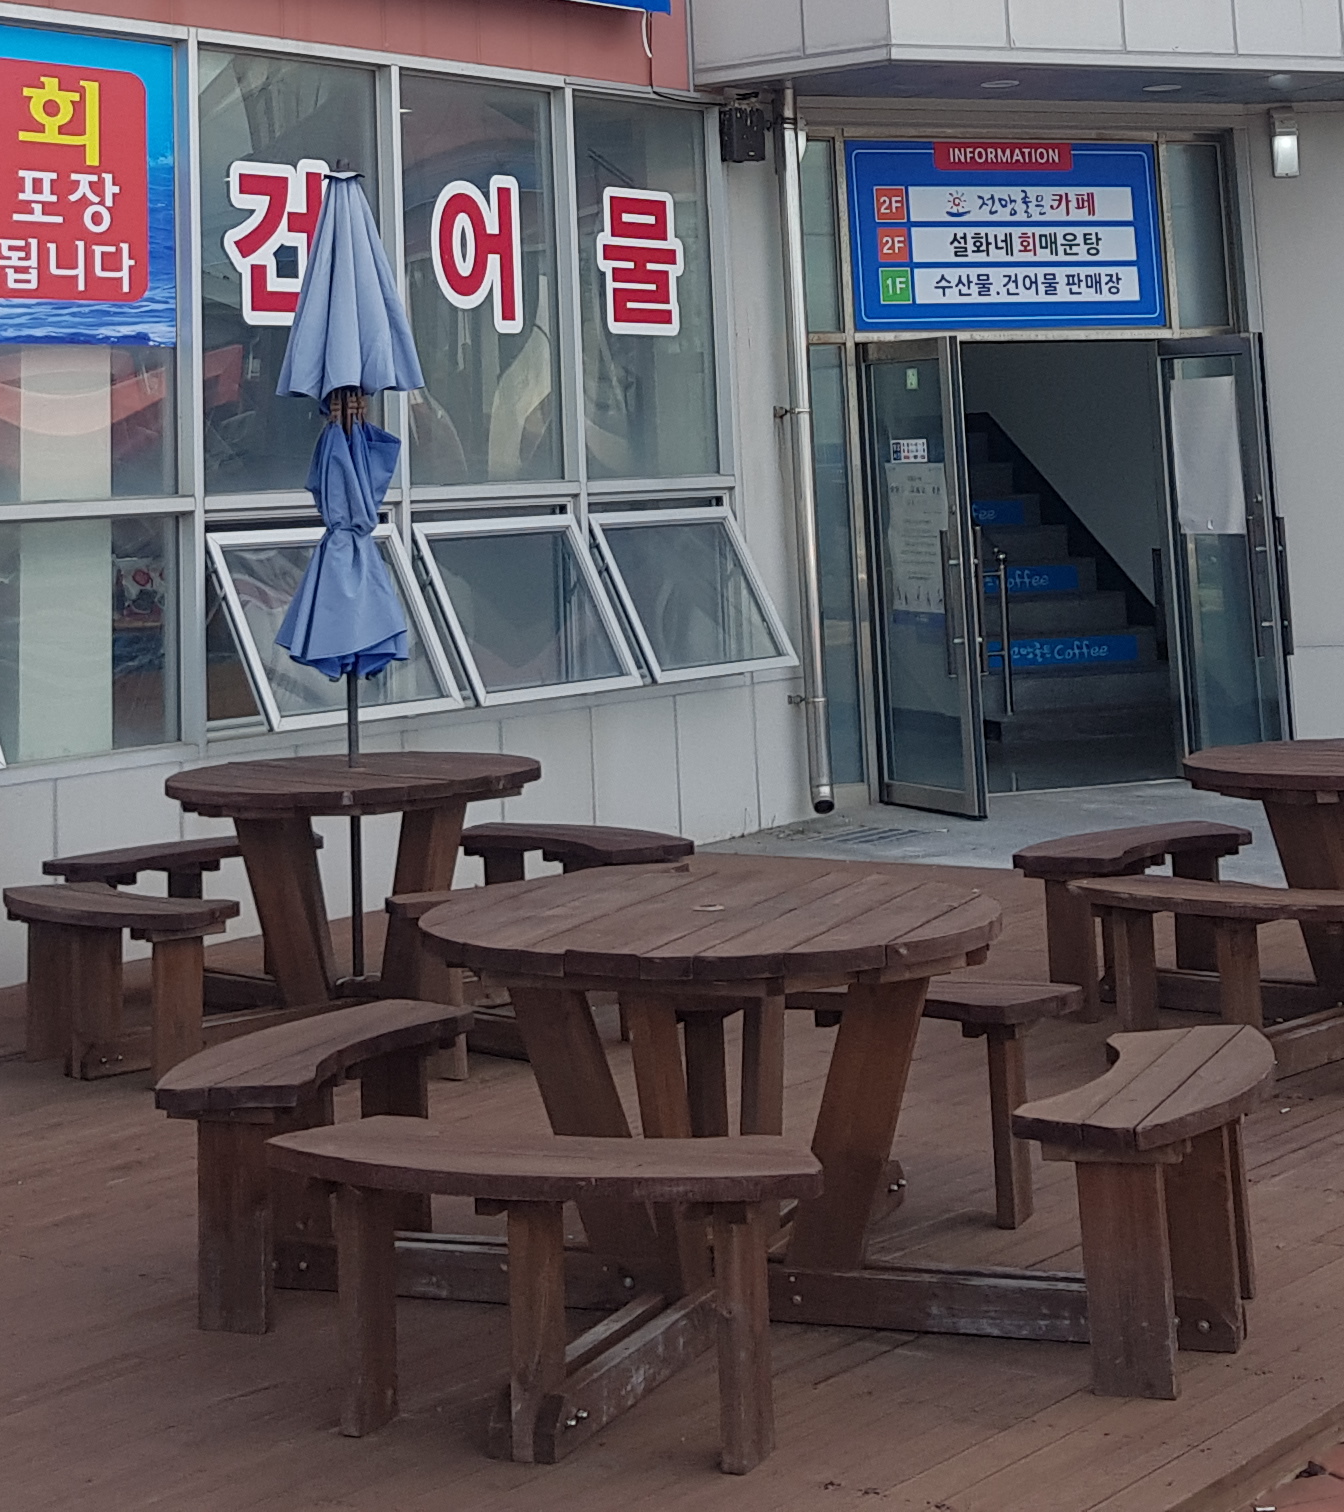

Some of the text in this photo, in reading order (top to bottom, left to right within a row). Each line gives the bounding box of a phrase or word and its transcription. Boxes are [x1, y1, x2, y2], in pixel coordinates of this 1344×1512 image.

[18, 76, 100, 166] 회
[949, 146, 1060, 164] INFORMATION
[12, 169, 120, 233] 포장
[879, 196, 902, 214] 2F
[882, 236, 905, 254] 2F
[886, 277, 906, 294] 1F
[1064, 272, 1122, 296] 판매장
[1054, 640, 1110, 660] Coffee
